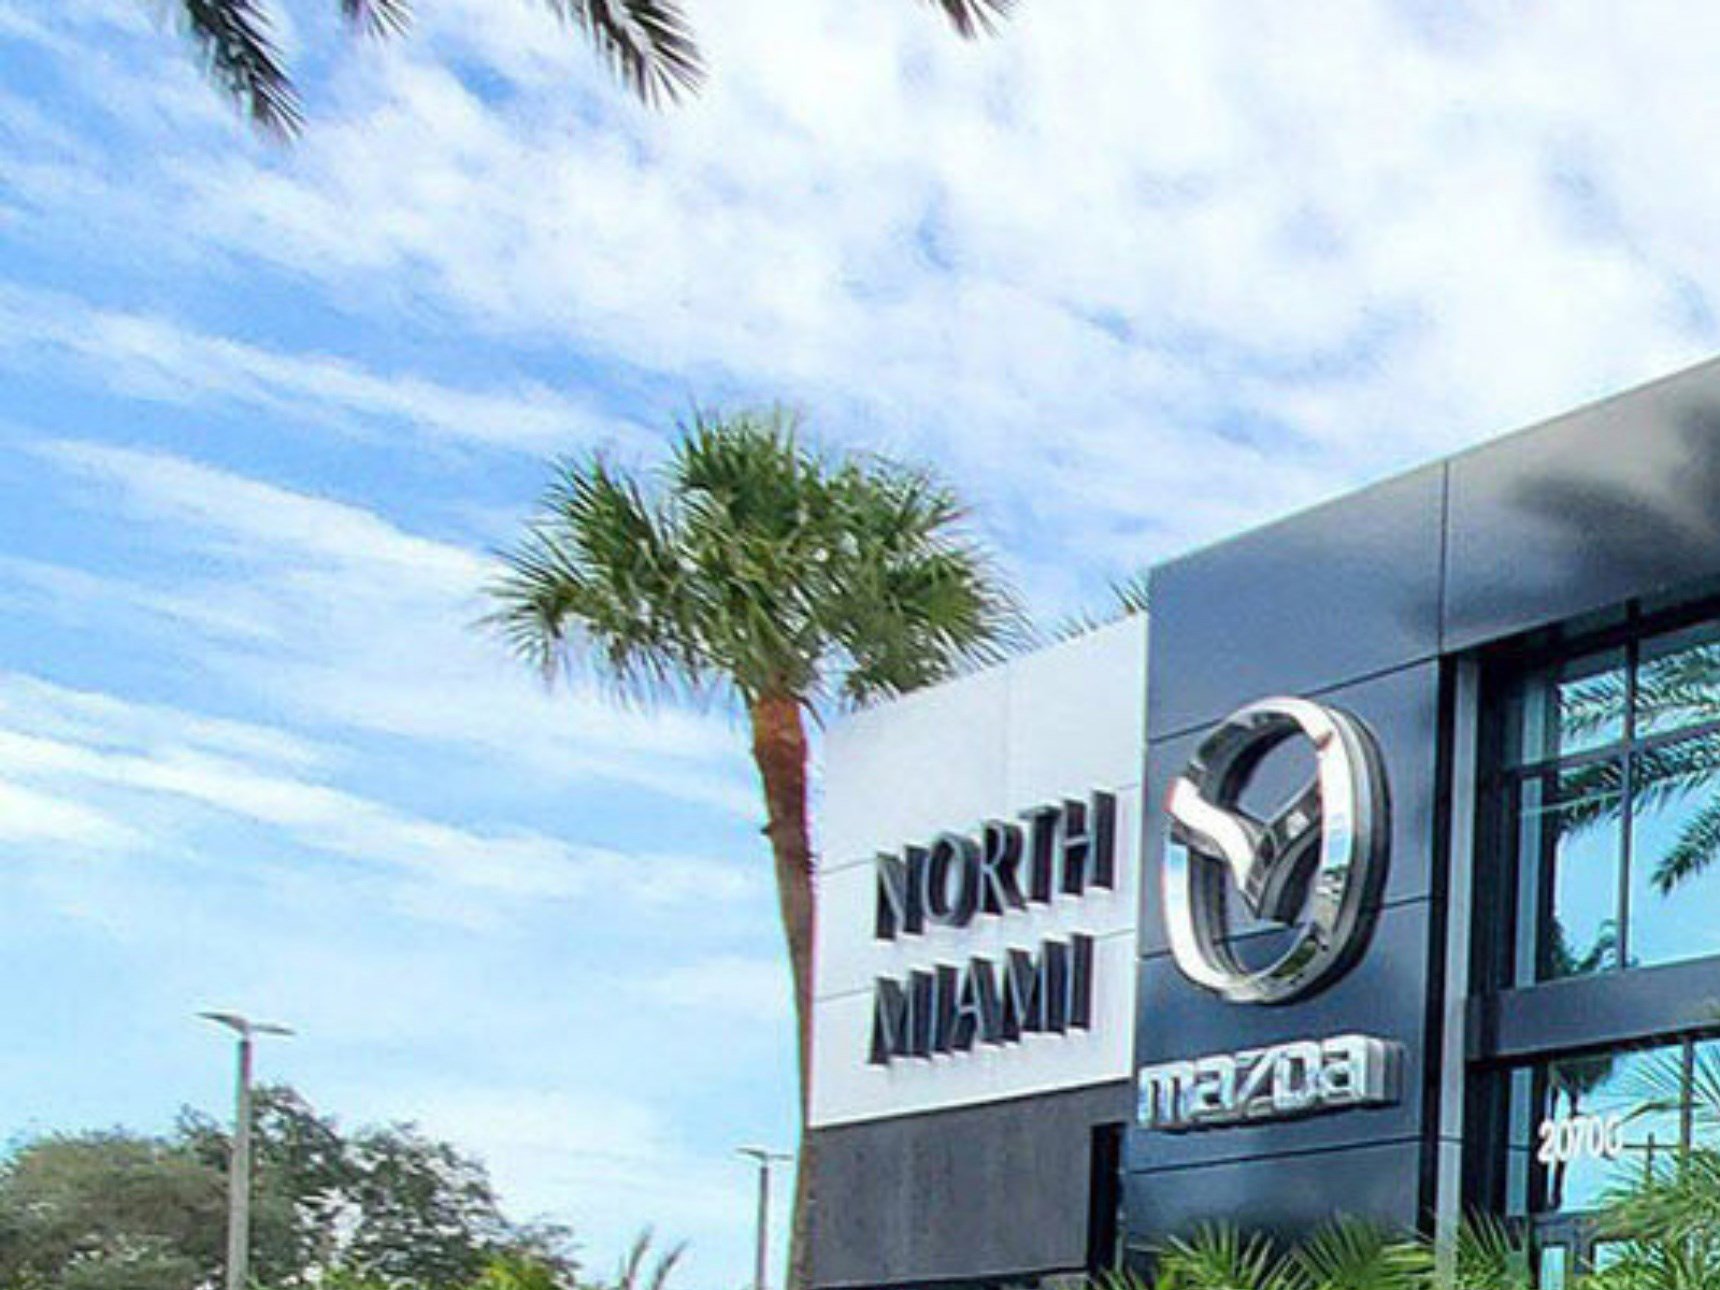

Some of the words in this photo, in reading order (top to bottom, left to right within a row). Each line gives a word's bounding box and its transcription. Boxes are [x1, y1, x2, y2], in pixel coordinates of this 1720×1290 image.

[873, 788, 1116, 940] NORTH
[868, 932, 1093, 1065] MIAMI
[1536, 1113, 1624, 1165] 20700
